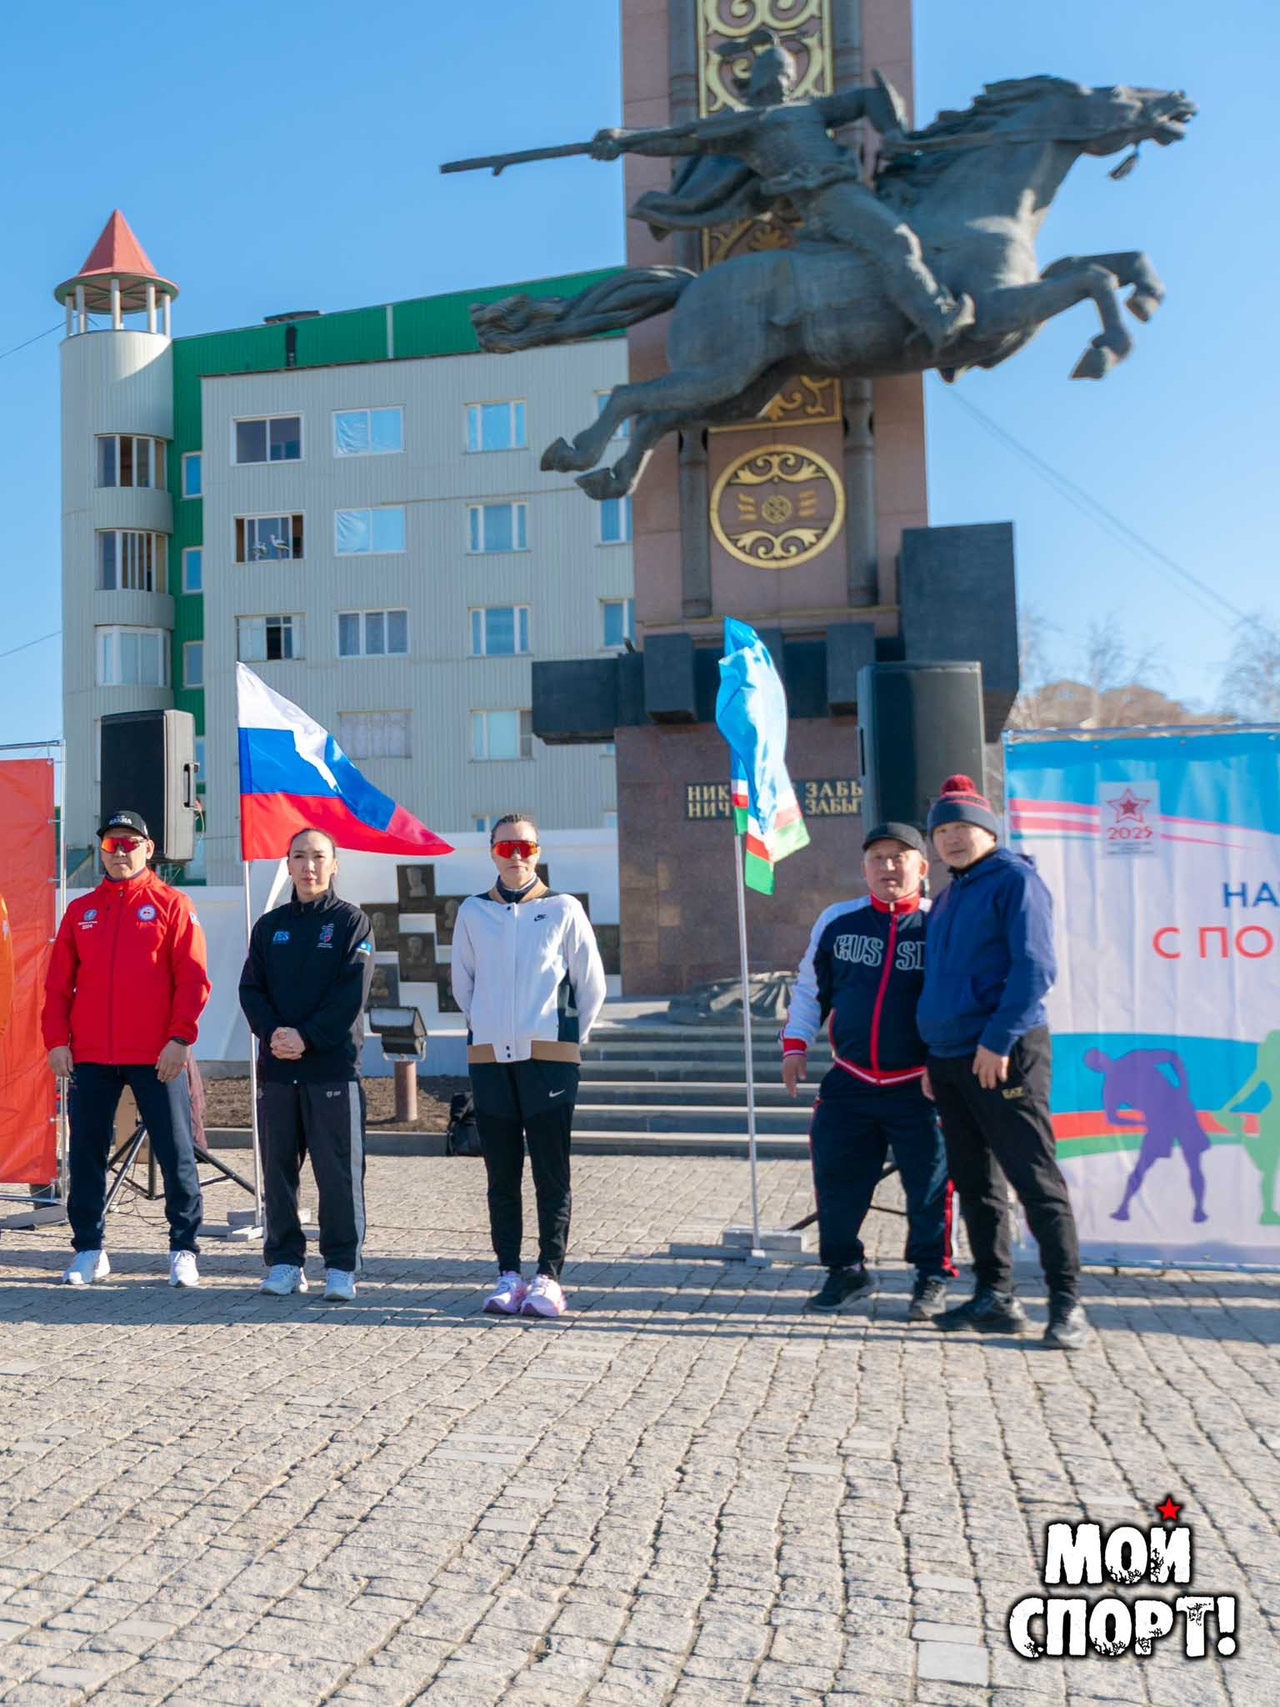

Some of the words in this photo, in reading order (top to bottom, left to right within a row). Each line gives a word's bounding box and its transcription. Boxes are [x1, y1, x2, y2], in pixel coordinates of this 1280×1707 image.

[688, 784, 730, 801] НИК
[688, 801, 730, 818] НИЧ
[1107, 826, 1153, 840] 2025
[1223, 882, 1280, 908] НА
[1152, 926, 1181, 959] С
[1198, 925, 1280, 959] ПО
